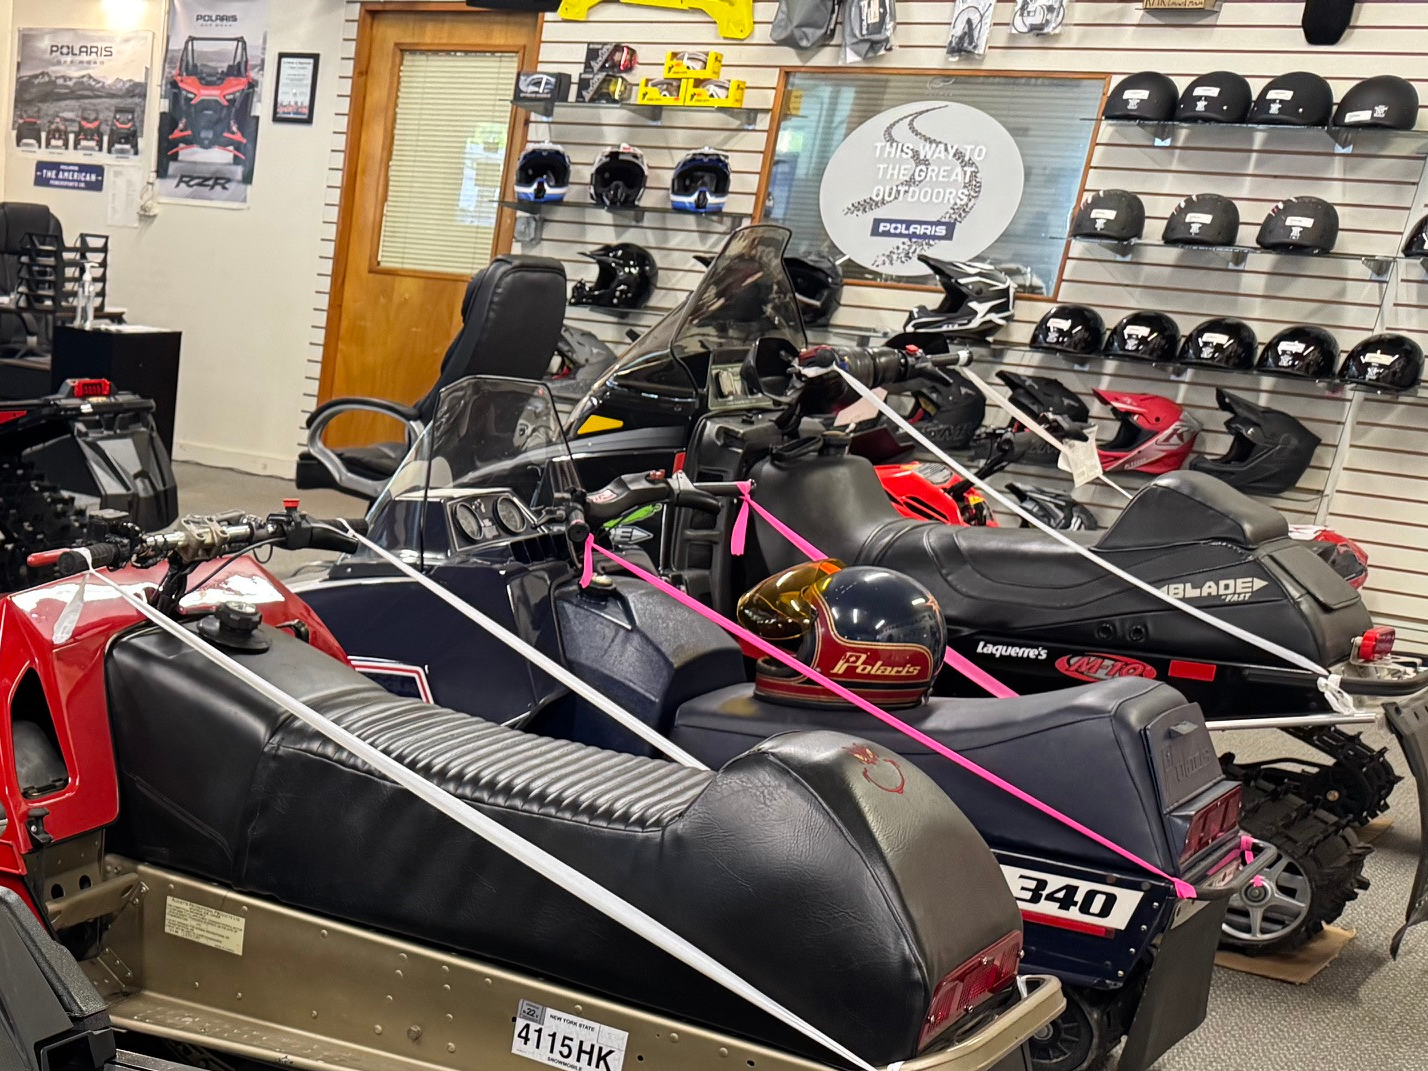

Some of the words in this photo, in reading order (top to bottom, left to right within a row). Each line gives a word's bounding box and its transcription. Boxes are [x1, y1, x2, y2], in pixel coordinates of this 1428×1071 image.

[196, 14, 238, 22] POLARIS
[50, 45, 113, 57] POLARIS
[874, 142, 913, 158] THIS
[919, 143, 956, 160] WAY
[965, 144, 987, 161] TO
[42, 169, 56, 178] THE
[58, 170, 97, 182] AMERICAN
[877, 163, 911, 180] THE
[914, 165, 974, 182] GREAT
[174, 174, 232, 191] RZR
[872, 185, 969, 203] OUTDOORS
[878, 222, 947, 236] POLARIS
[1168, 577, 1253, 599] BLADE
[976, 640, 1048, 660] Laquerre's
[830, 651, 921, 677] Polaris
[1068, 656, 1145, 677] M-10
[1015, 874, 1118, 919] 340
[526, 1008, 537, 1018] 22
[550, 1014, 562, 1022] NEW
[563, 1017, 578, 1027] YORK
[578, 1022, 595, 1032] STATE
[547, 1056, 583, 1071] SNOWMOBILE
